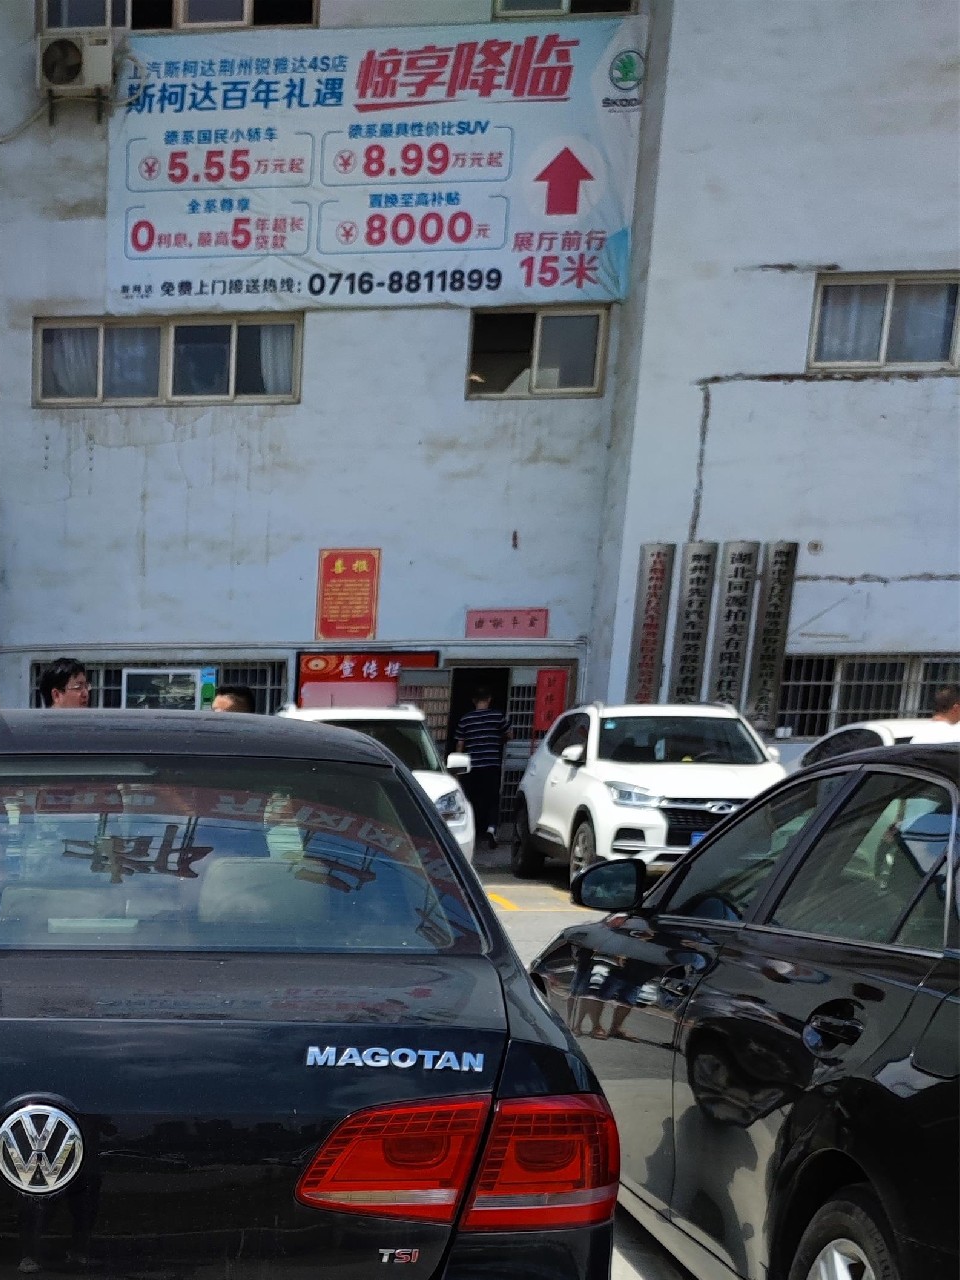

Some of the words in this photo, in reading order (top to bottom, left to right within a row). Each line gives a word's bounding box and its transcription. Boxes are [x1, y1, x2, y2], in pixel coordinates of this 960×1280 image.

[355, 33, 580, 99] 惊享降临
[127, 77, 345, 114] 斯柯达百年礼遇
[513, 230, 608, 252] 展厅前行
[520, 253, 599, 289] 15米
[306, 1046, 485, 1073] MAGOTAN
[378, 1248, 420, 1264] TSI
